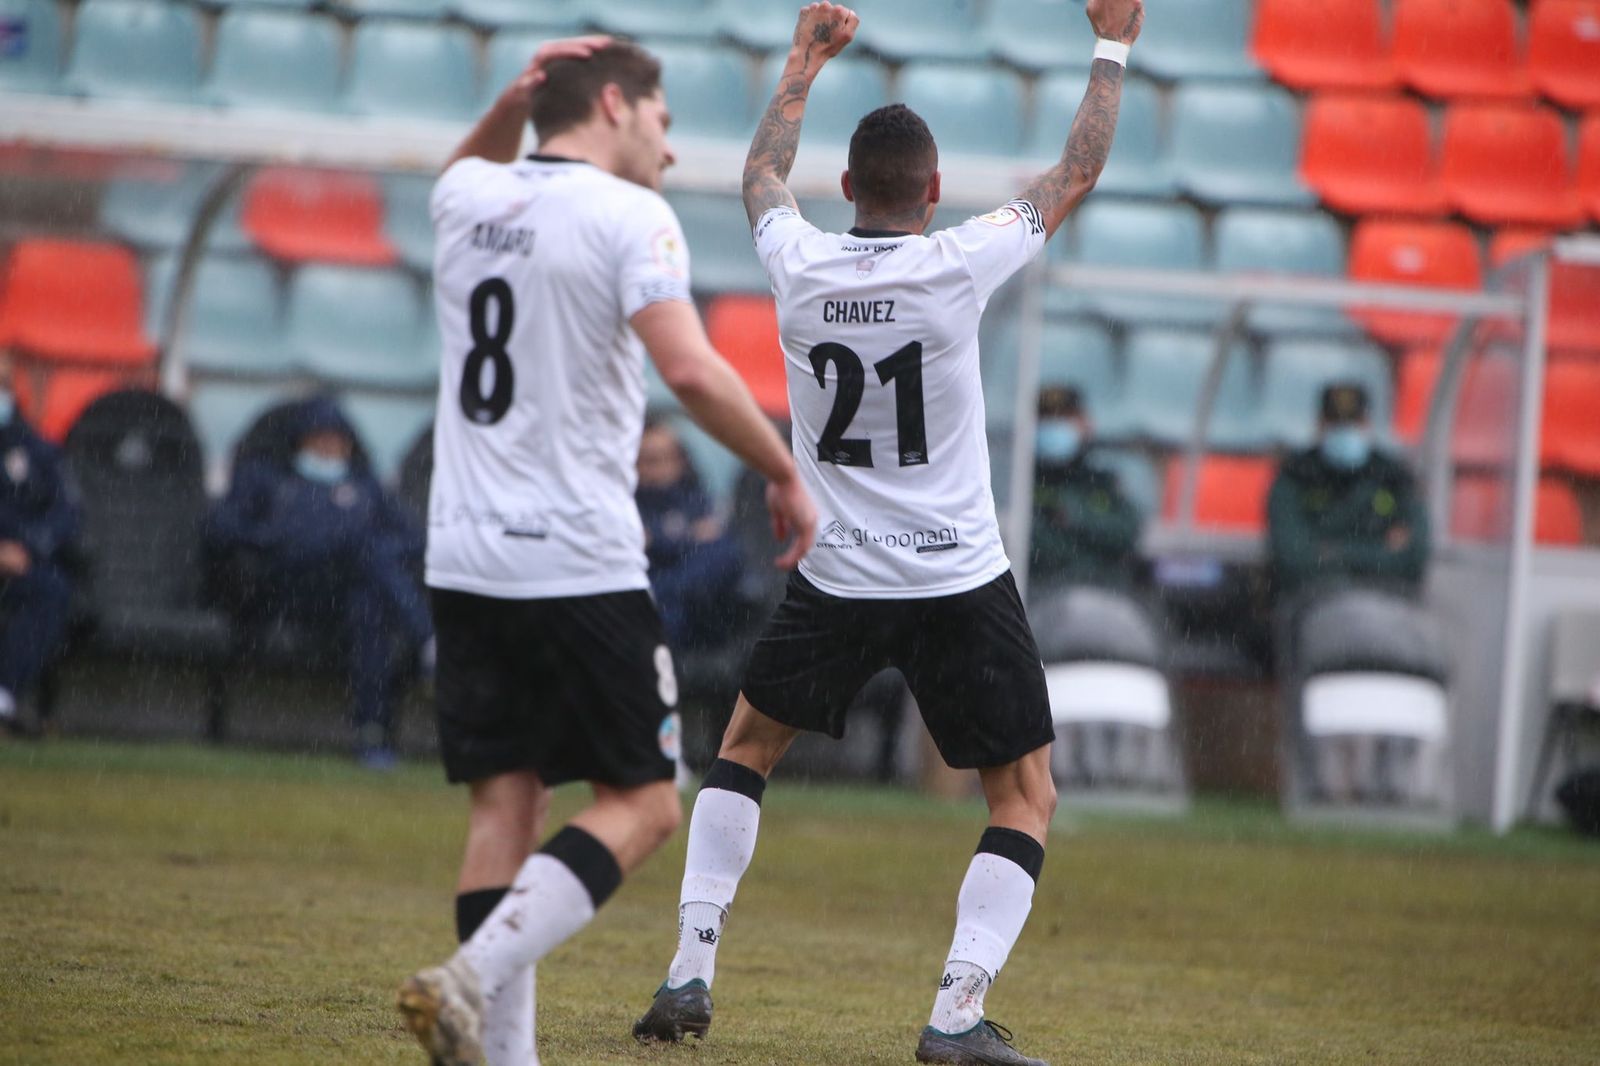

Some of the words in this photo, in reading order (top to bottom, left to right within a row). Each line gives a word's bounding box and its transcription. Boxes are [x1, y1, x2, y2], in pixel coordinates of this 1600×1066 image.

[460, 276, 514, 426] 8
[823, 300, 896, 323] CHAVEZ
[808, 340, 929, 468] 21
